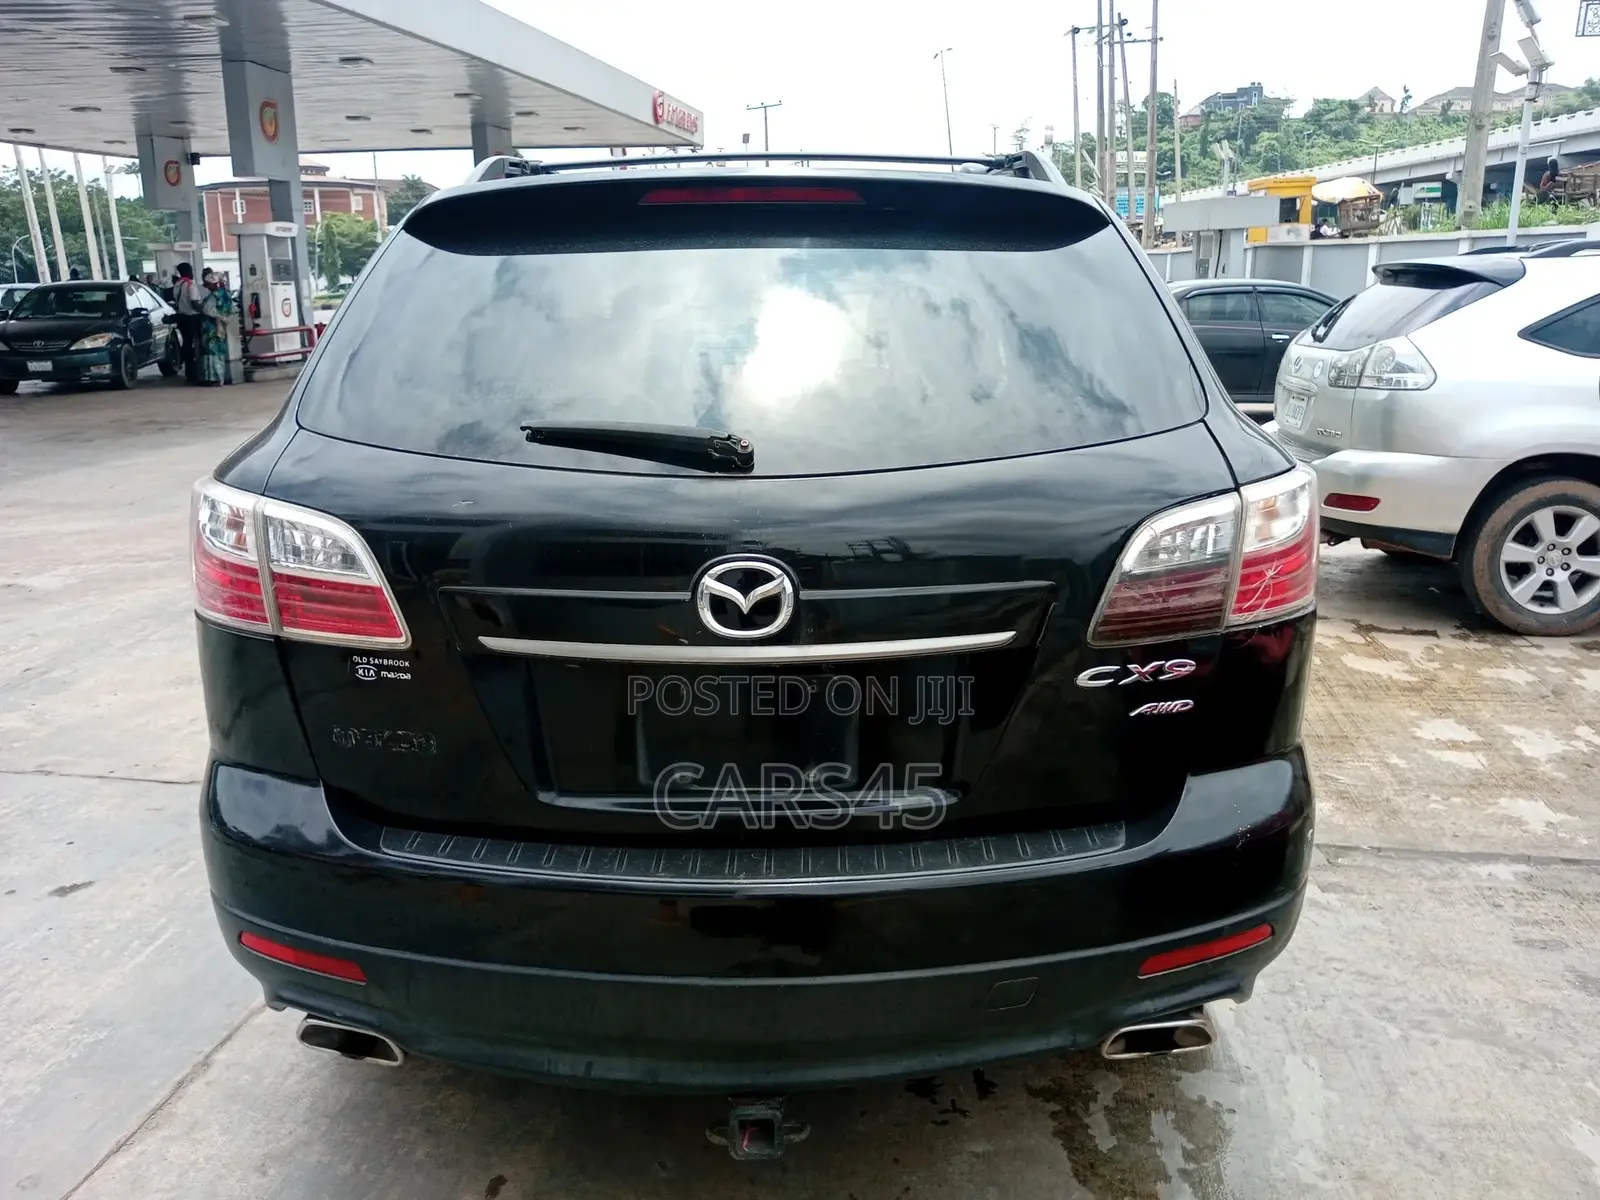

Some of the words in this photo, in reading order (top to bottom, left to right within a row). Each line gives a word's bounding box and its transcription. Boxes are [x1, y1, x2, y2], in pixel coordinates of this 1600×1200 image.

[352, 655, 368, 664] OLD
[369, 657, 410, 667] SAYBROOK
[357, 666, 376, 679] KIA
[1074, 659, 1196, 688] CX9
[1128, 699, 1195, 717] AWD
